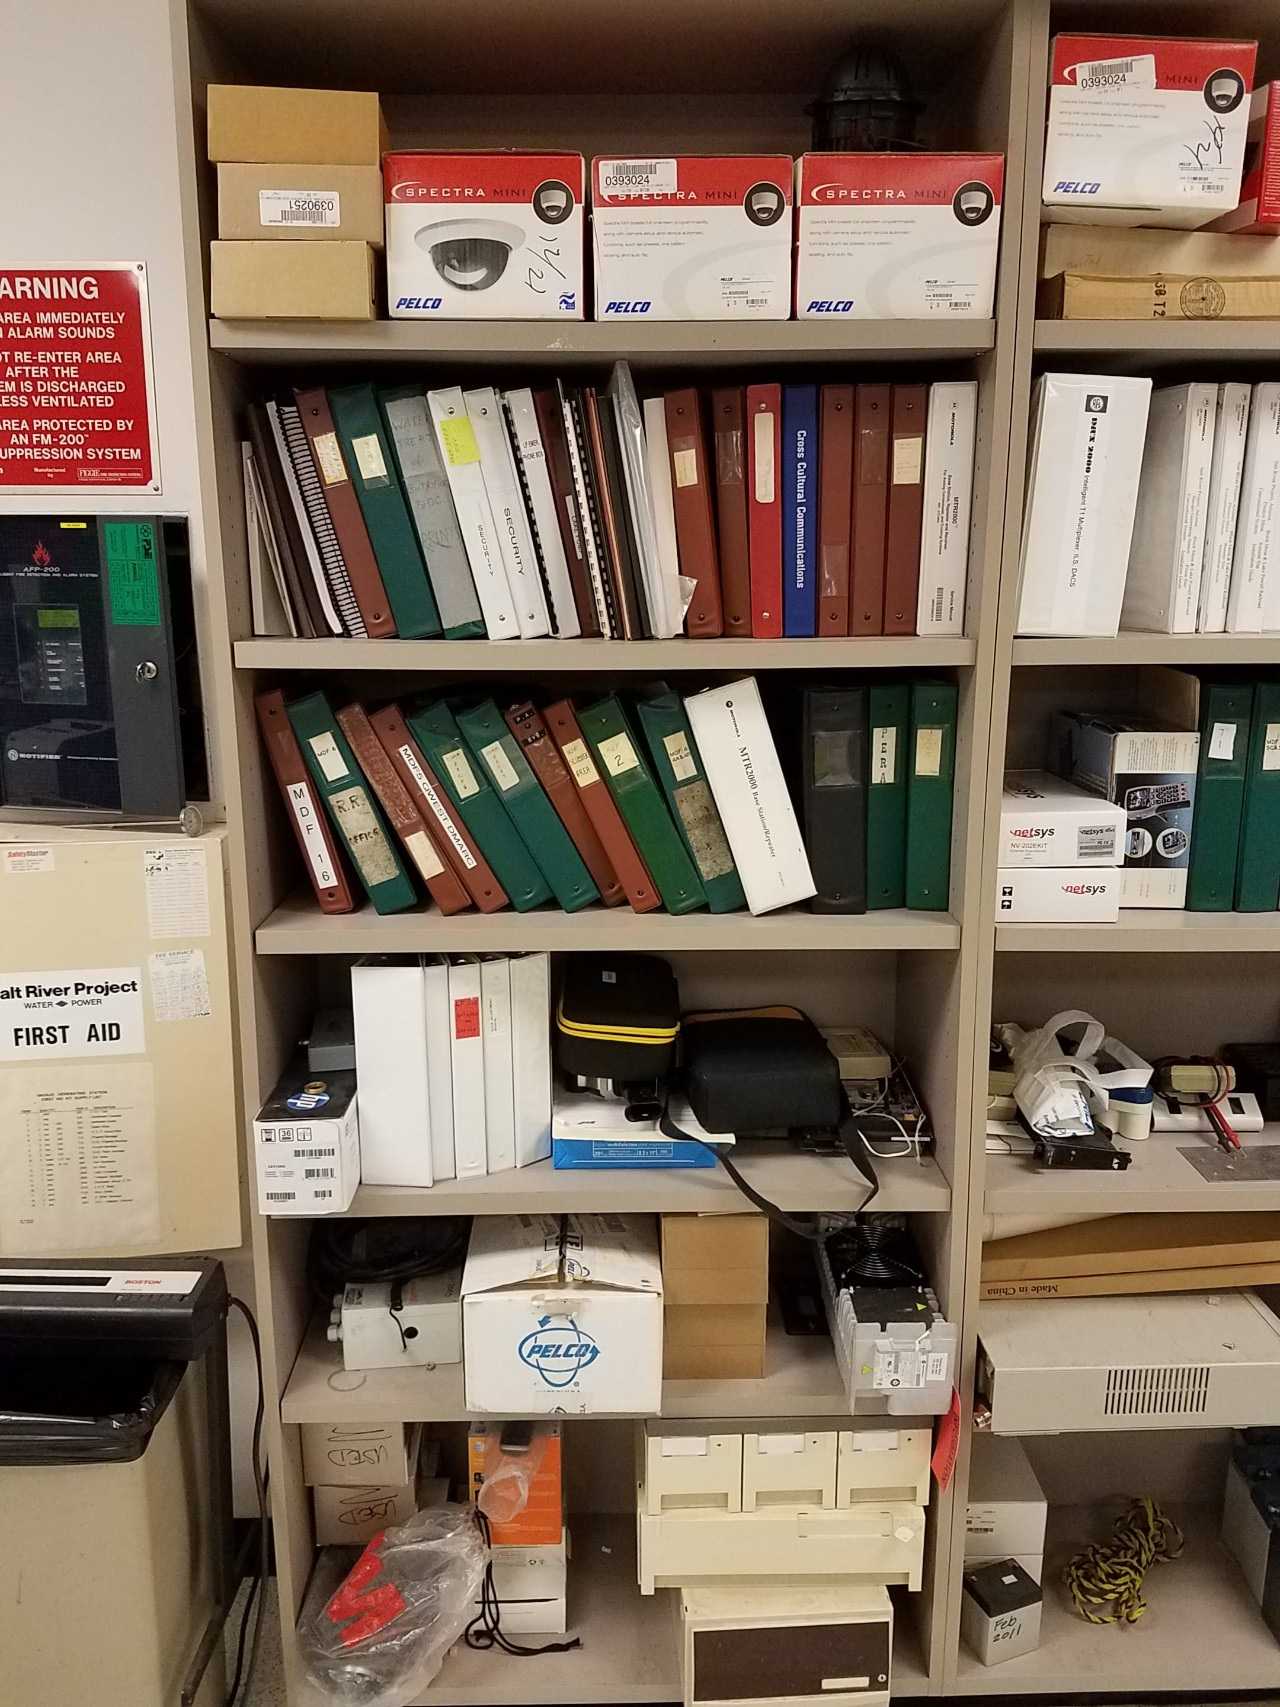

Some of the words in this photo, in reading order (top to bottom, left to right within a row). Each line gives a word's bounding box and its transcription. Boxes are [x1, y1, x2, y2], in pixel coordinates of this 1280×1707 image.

[1081, 74, 1127, 89] 0393024
[1166, 75, 1198, 85] MINI
[605, 175, 650, 186] 0393024
[405, 187, 485, 198] SPECTRA
[493, 188, 527, 197] MINI
[1053, 181, 1100, 194] PELCO
[618, 191, 697, 200] SPECTRA
[705, 191, 737, 200] MINI
[826, 190, 907, 199] SPECTRA
[914, 190, 946, 199] MINI
[289, 200, 334, 211] 0390251
[396, 297, 442, 310] PELCO
[605, 301, 651, 313] PELCO
[807, 300, 854, 313] PELCO
[36, 312, 125, 324] IMMEDIATELY
[8, 327, 54, 339] ALARM
[58, 327, 115, 339] SOUNDS
[14, 351, 82, 363] RE-ENTER
[86, 351, 122, 363] AREA
[5, 366, 49, 378] AFTER
[52, 366, 79, 378] THE
[20, 381, 33, 393] IS
[37, 381, 126, 393] DISCHARGED
[32, 395, 114, 408] VENTILATED
[33, 420, 112, 431] PROTECTED
[116, 420, 134, 431] BY
[10, 434, 28, 445] AN
[797, 430, 807, 459] Cross
[87, 448, 142, 460] SYSTEM
[1085, 445, 1095, 473] 2000
[796, 462, 807, 504] Cultural
[503, 507, 525, 576] SECURITY
[796, 506, 807, 589] Communications
[738, 746, 759, 792] MTR2000
[1011, 827, 1055, 839] netsys
[1061, 880, 1107, 896] netsys
[25, 984, 71, 999] River
[74, 980, 138, 997] Project
[71, 998, 103, 1007] POWER
[13, 1025, 70, 1047] FIRST
[87, 1022, 121, 1042] AID
[987, 1286, 1016, 1295] China
[1018, 1286, 1028, 1294] in
[1031, 1284, 1058, 1294] Made
[526, 1343, 591, 1358] PELCO
[327, 1445, 389, 1467] USED
[338, 1498, 397, 1526] USED
[993, 1614, 1018, 1631] Feb
